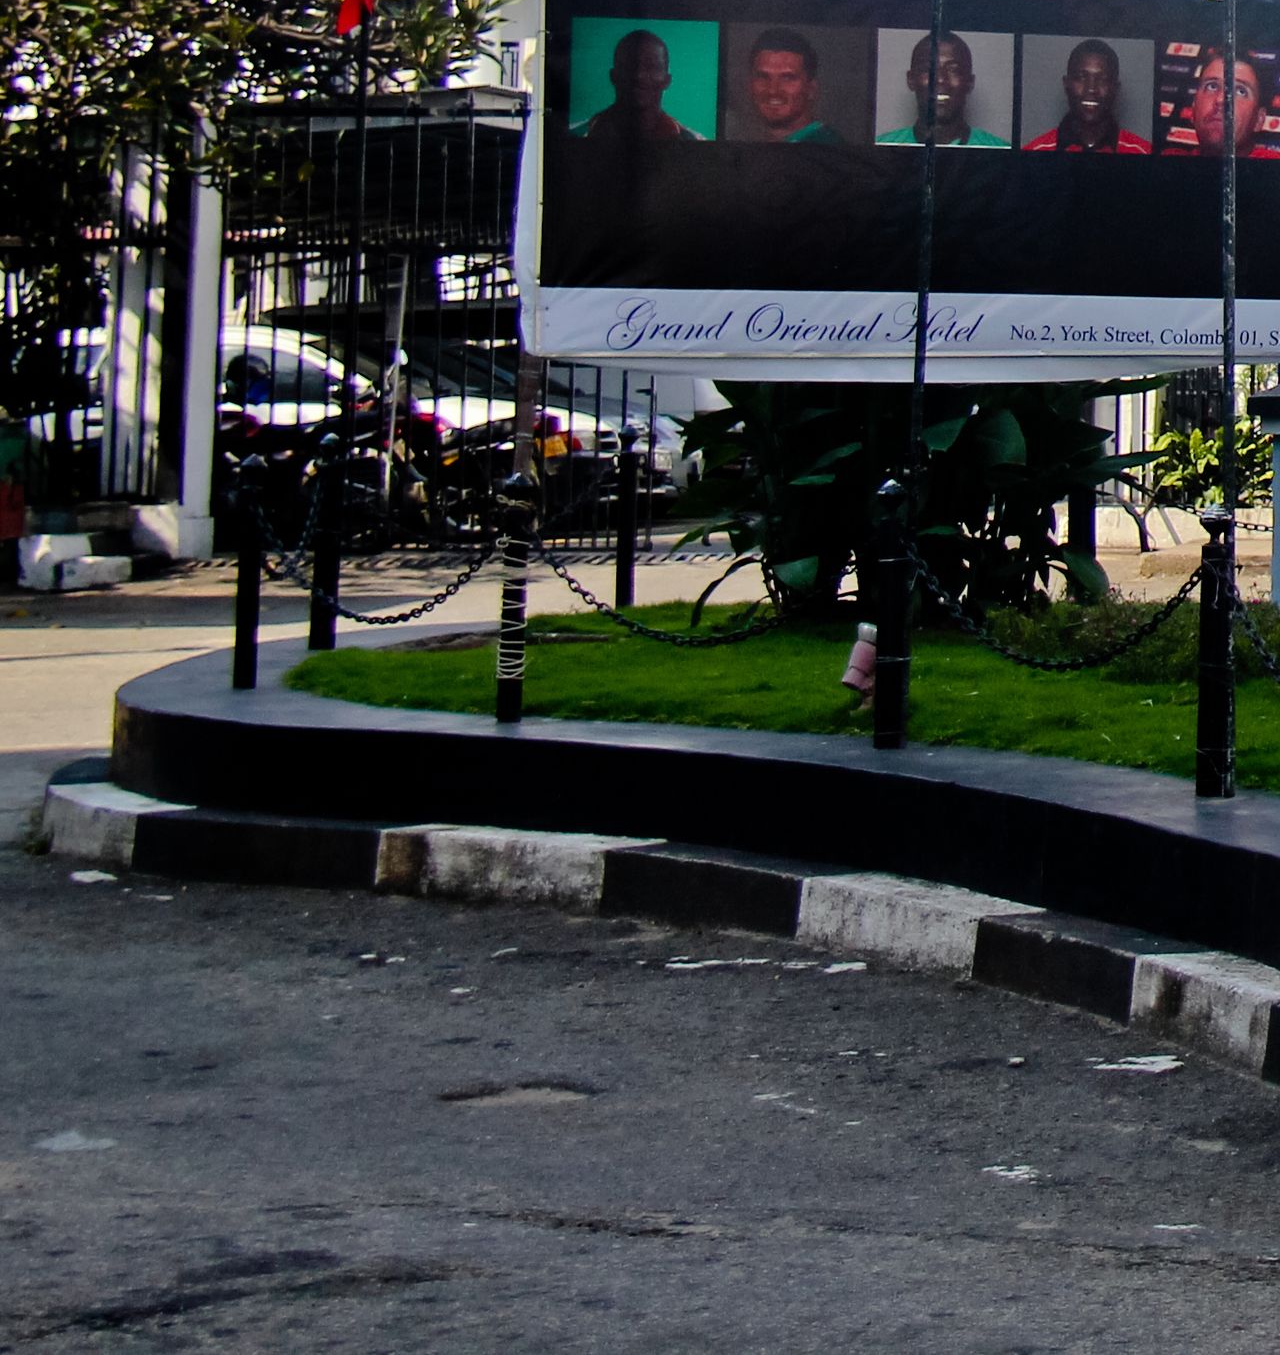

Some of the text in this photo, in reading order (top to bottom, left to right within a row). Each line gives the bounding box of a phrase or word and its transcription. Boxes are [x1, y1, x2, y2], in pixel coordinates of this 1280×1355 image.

[606, 297, 733, 350] Grand
[744, 302, 884, 343] Oriental
[1060, 325, 1098, 343] York
[1104, 325, 1155, 346] Street,
[1160, 327, 1226, 345] Colomb
[1239, 329, 1264, 349] 01,
